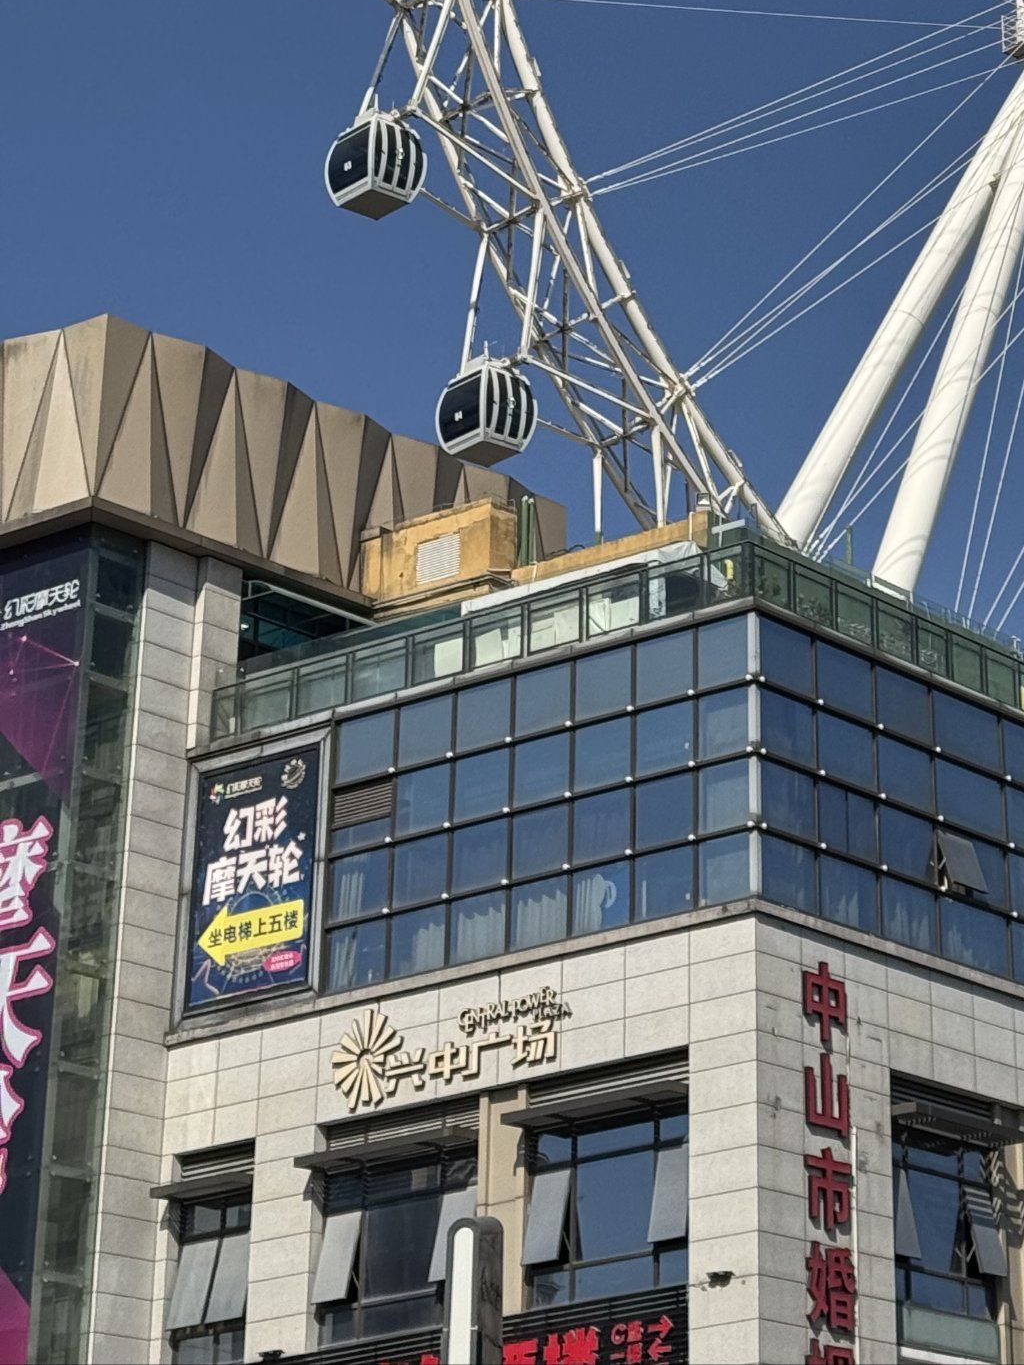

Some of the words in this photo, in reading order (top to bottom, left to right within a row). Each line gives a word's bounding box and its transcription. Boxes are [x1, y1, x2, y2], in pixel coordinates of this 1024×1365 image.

[223, 796, 288, 851] 幻彩
[202, 841, 303, 906] 摩天轮
[207, 911, 299, 948] 坐电梯上五楼
[385, 1021, 558, 1093] 兴中广场
